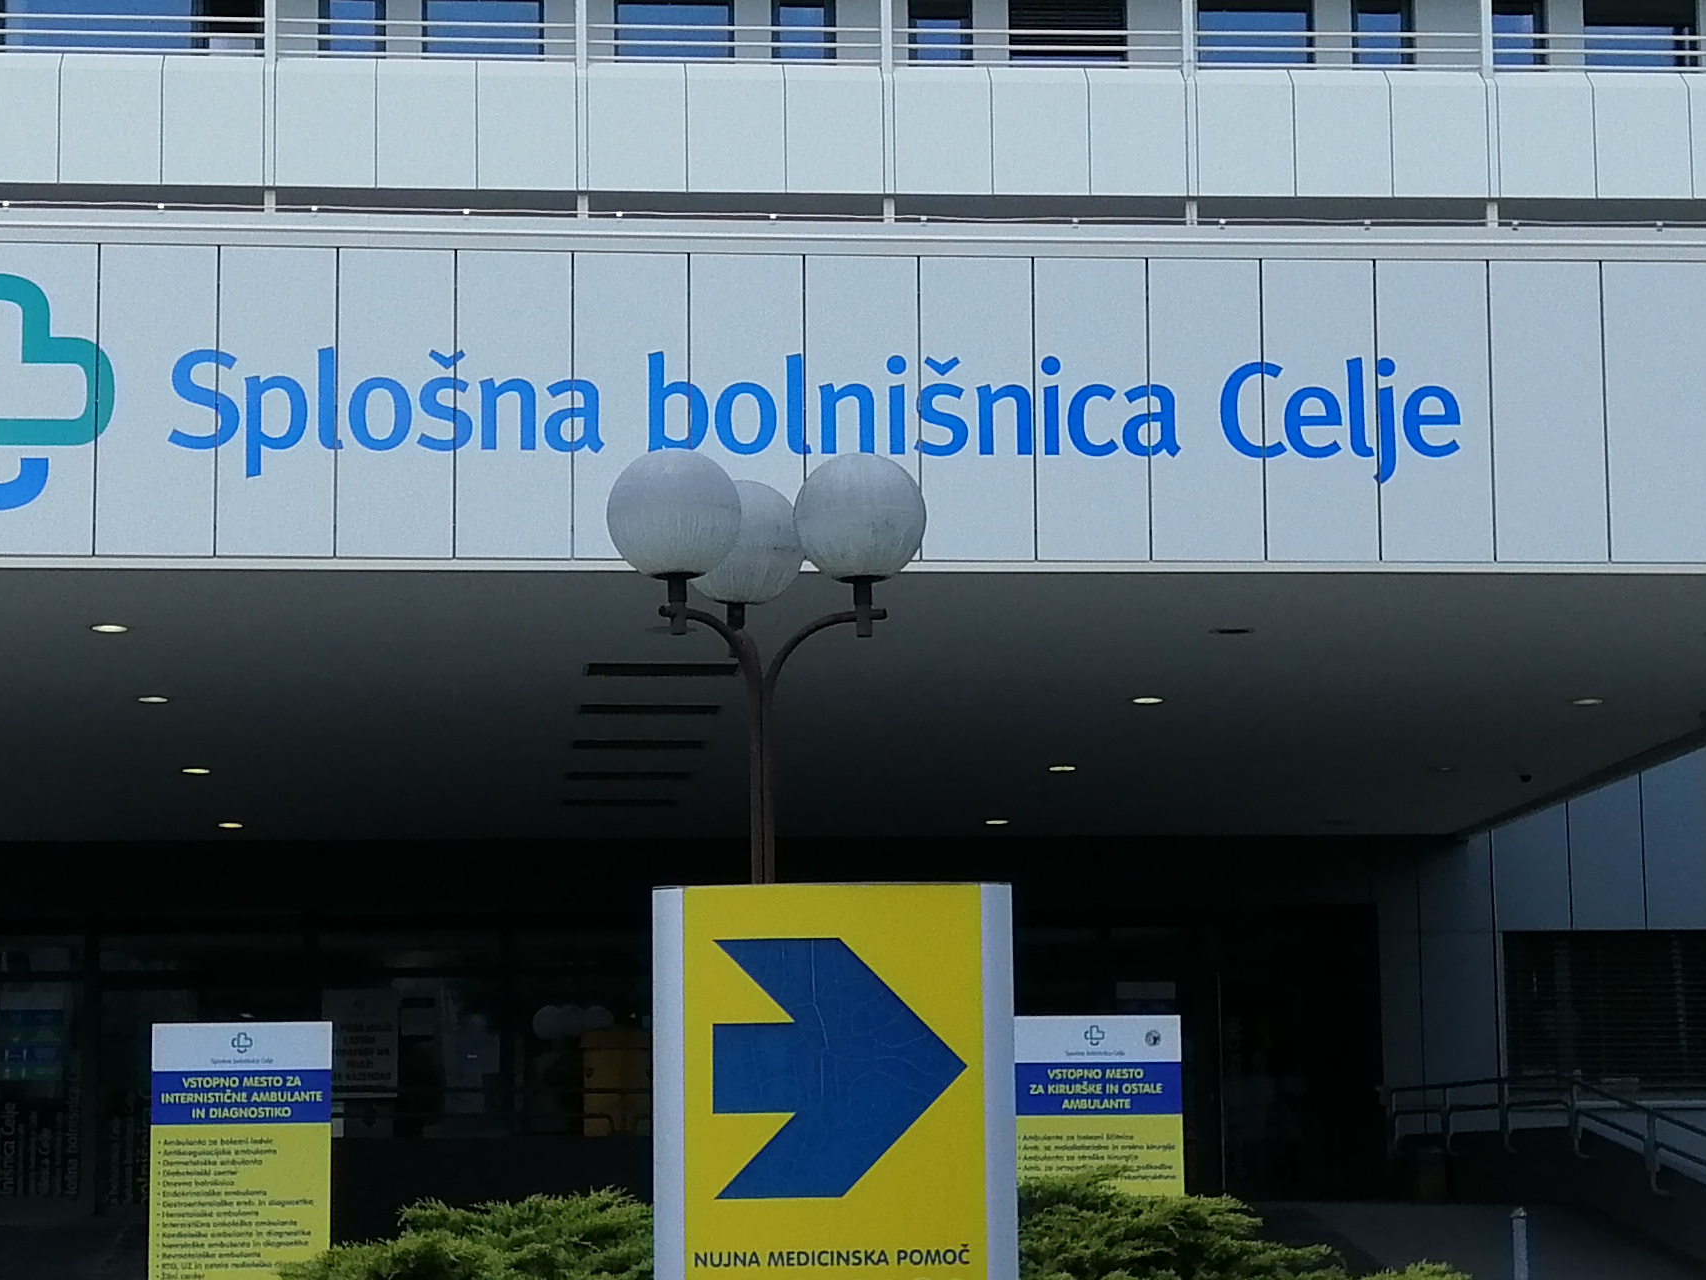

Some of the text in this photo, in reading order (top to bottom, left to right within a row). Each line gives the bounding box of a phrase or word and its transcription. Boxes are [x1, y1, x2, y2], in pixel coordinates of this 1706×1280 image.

[167, 345, 1462, 483] Splošna bolnišnica Celje
[1048, 1069, 1143, 1079] VSTOPNO MESTO
[182, 1076, 301, 1088] VSTOPNO MESTO ZA
[1030, 1082, 1162, 1094] ZA KIRURŠKE IN OSTALE
[161, 1090, 322, 1103] INTERNISTIČNE AMBULANTE
[1062, 1099, 1131, 1109] AMBULANTE
[192, 1107, 291, 1118] IN DIAGNOSTIKO
[694, 1244, 970, 1268] NUJNA MEDICINSKA POMOČ
